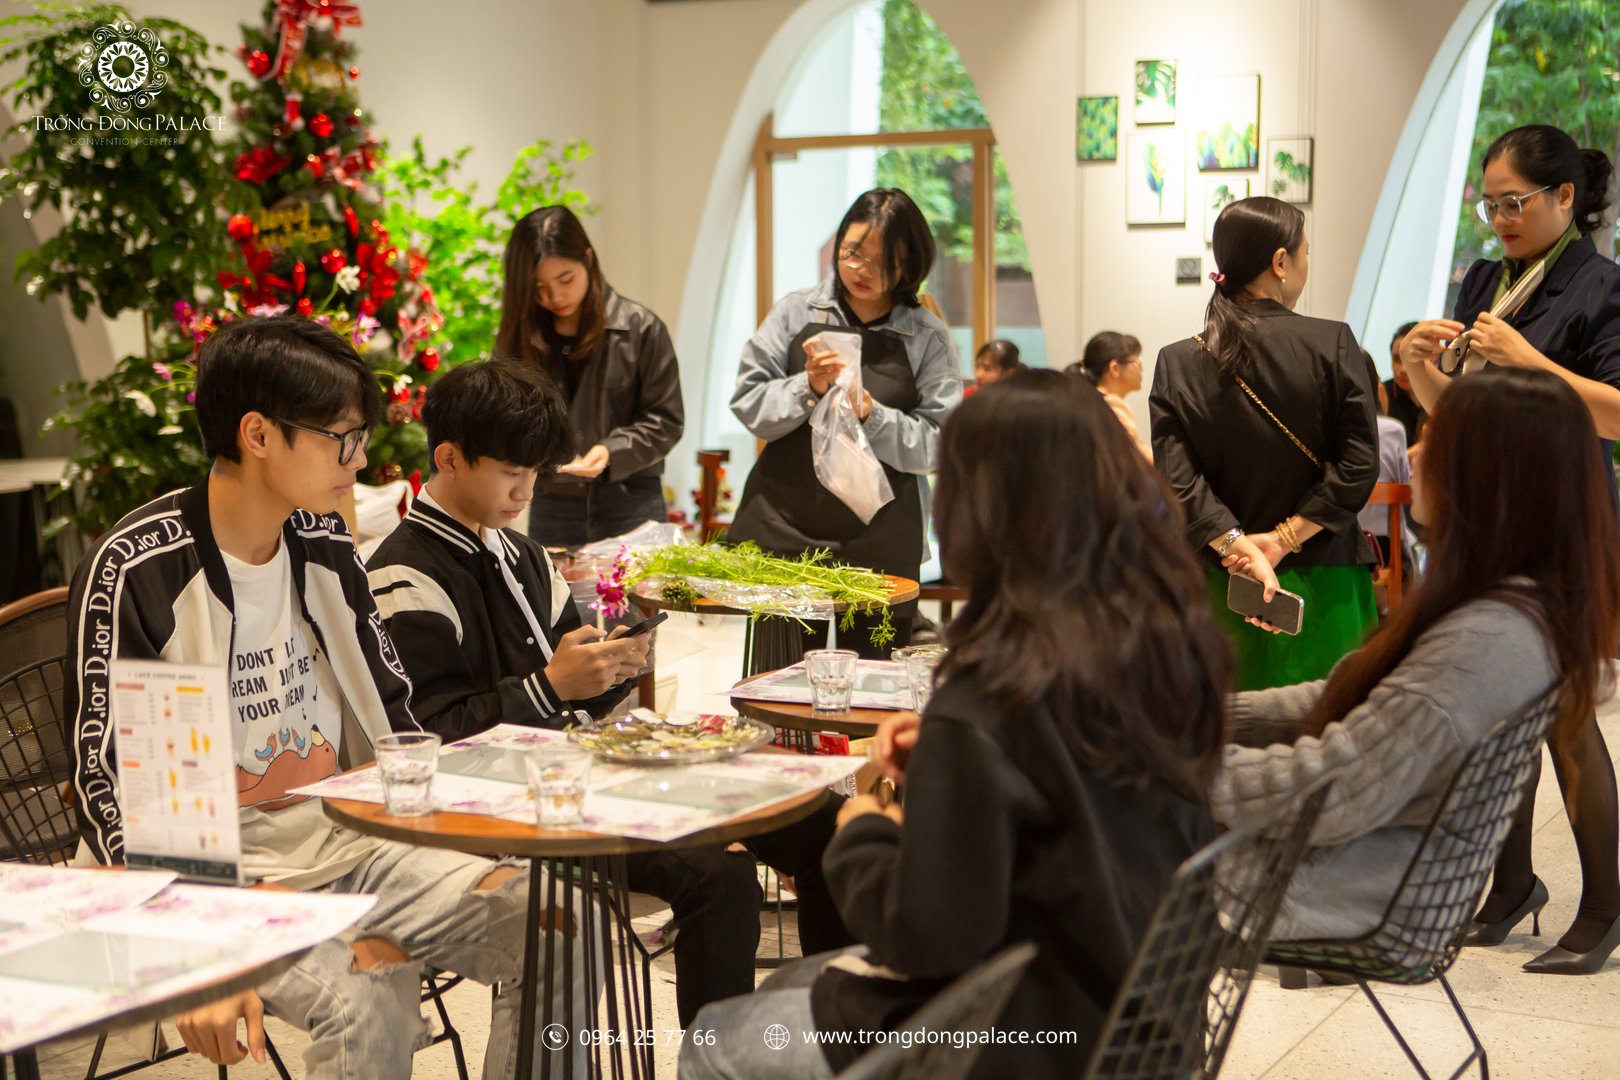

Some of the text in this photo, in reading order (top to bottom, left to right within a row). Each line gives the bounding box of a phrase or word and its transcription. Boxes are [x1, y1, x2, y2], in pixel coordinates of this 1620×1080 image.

[108, 531, 161, 560] D.ior
[88, 556, 118, 614] D.ior
[84, 619, 111, 677] D.ior
[236, 647, 274, 671] DONT
[232, 676, 268, 698] REAM
[298, 656, 310, 675] BE
[81, 682, 107, 740] D.ior
[238, 698, 281, 723] YOUR
[85, 745, 111, 801] D.ior
